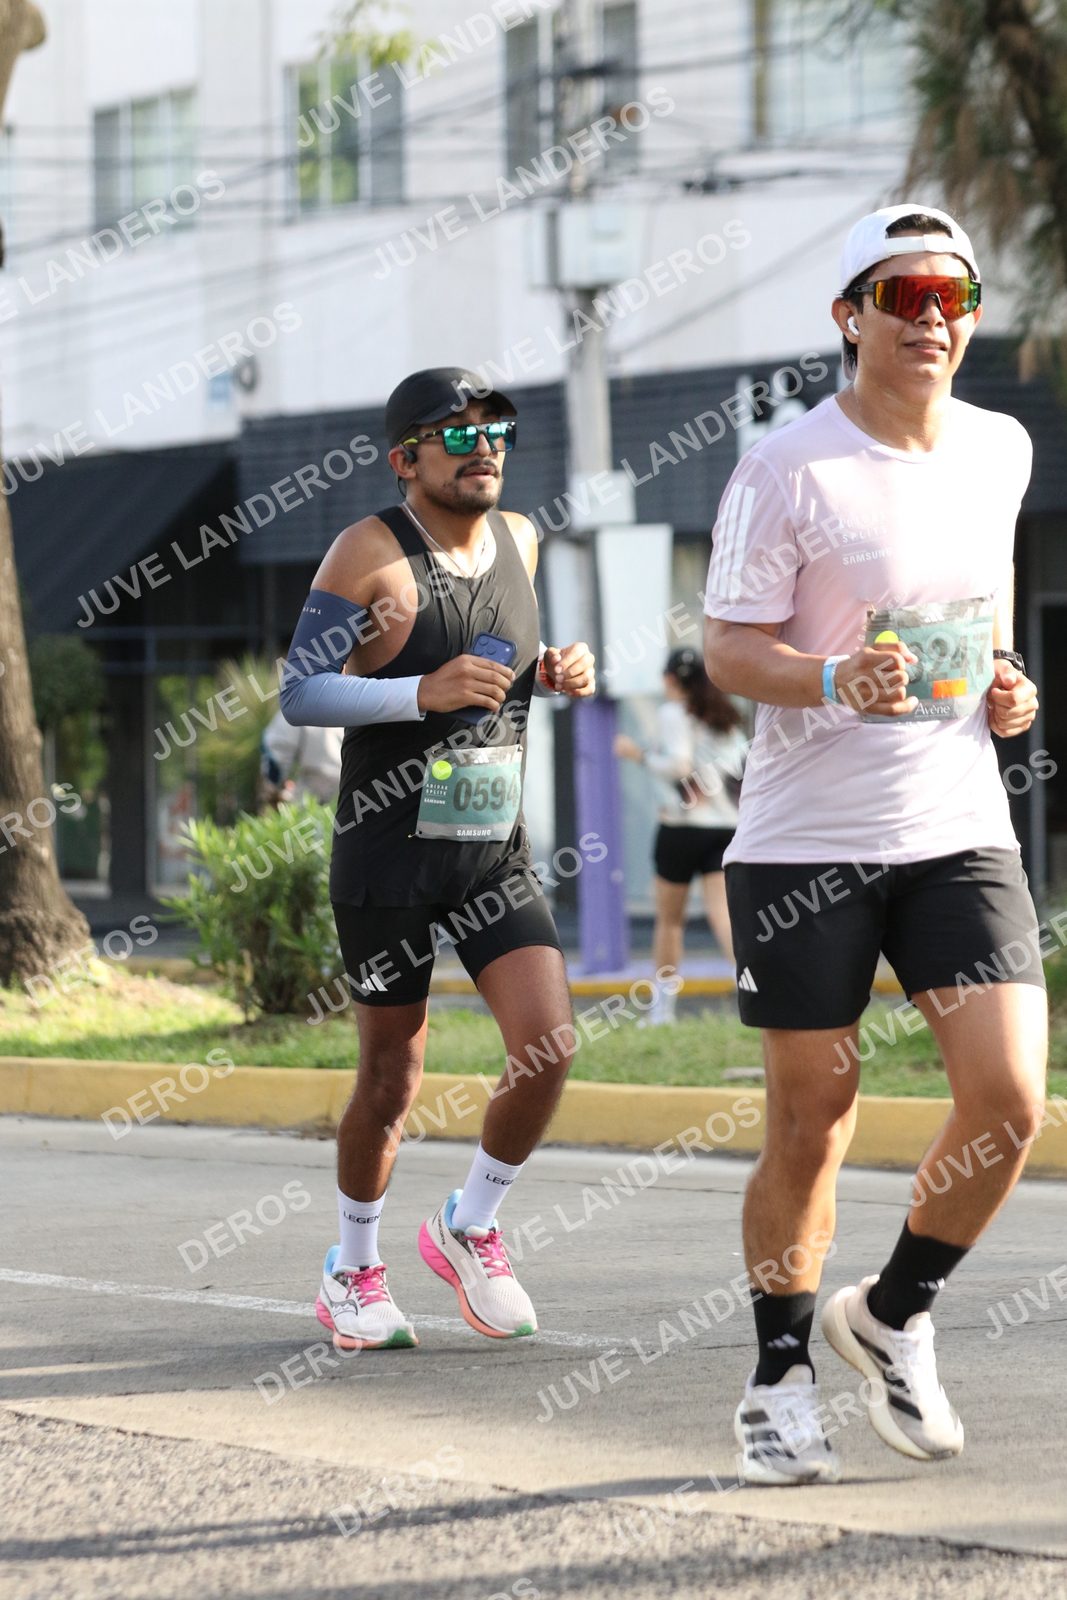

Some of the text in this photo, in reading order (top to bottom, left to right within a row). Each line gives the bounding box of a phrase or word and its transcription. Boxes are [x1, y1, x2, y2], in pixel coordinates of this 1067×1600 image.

[453, 772, 521, 812] 0594
[456, 829, 492, 837] SAMSUNG
[486, 1173, 513, 1185] LEG
